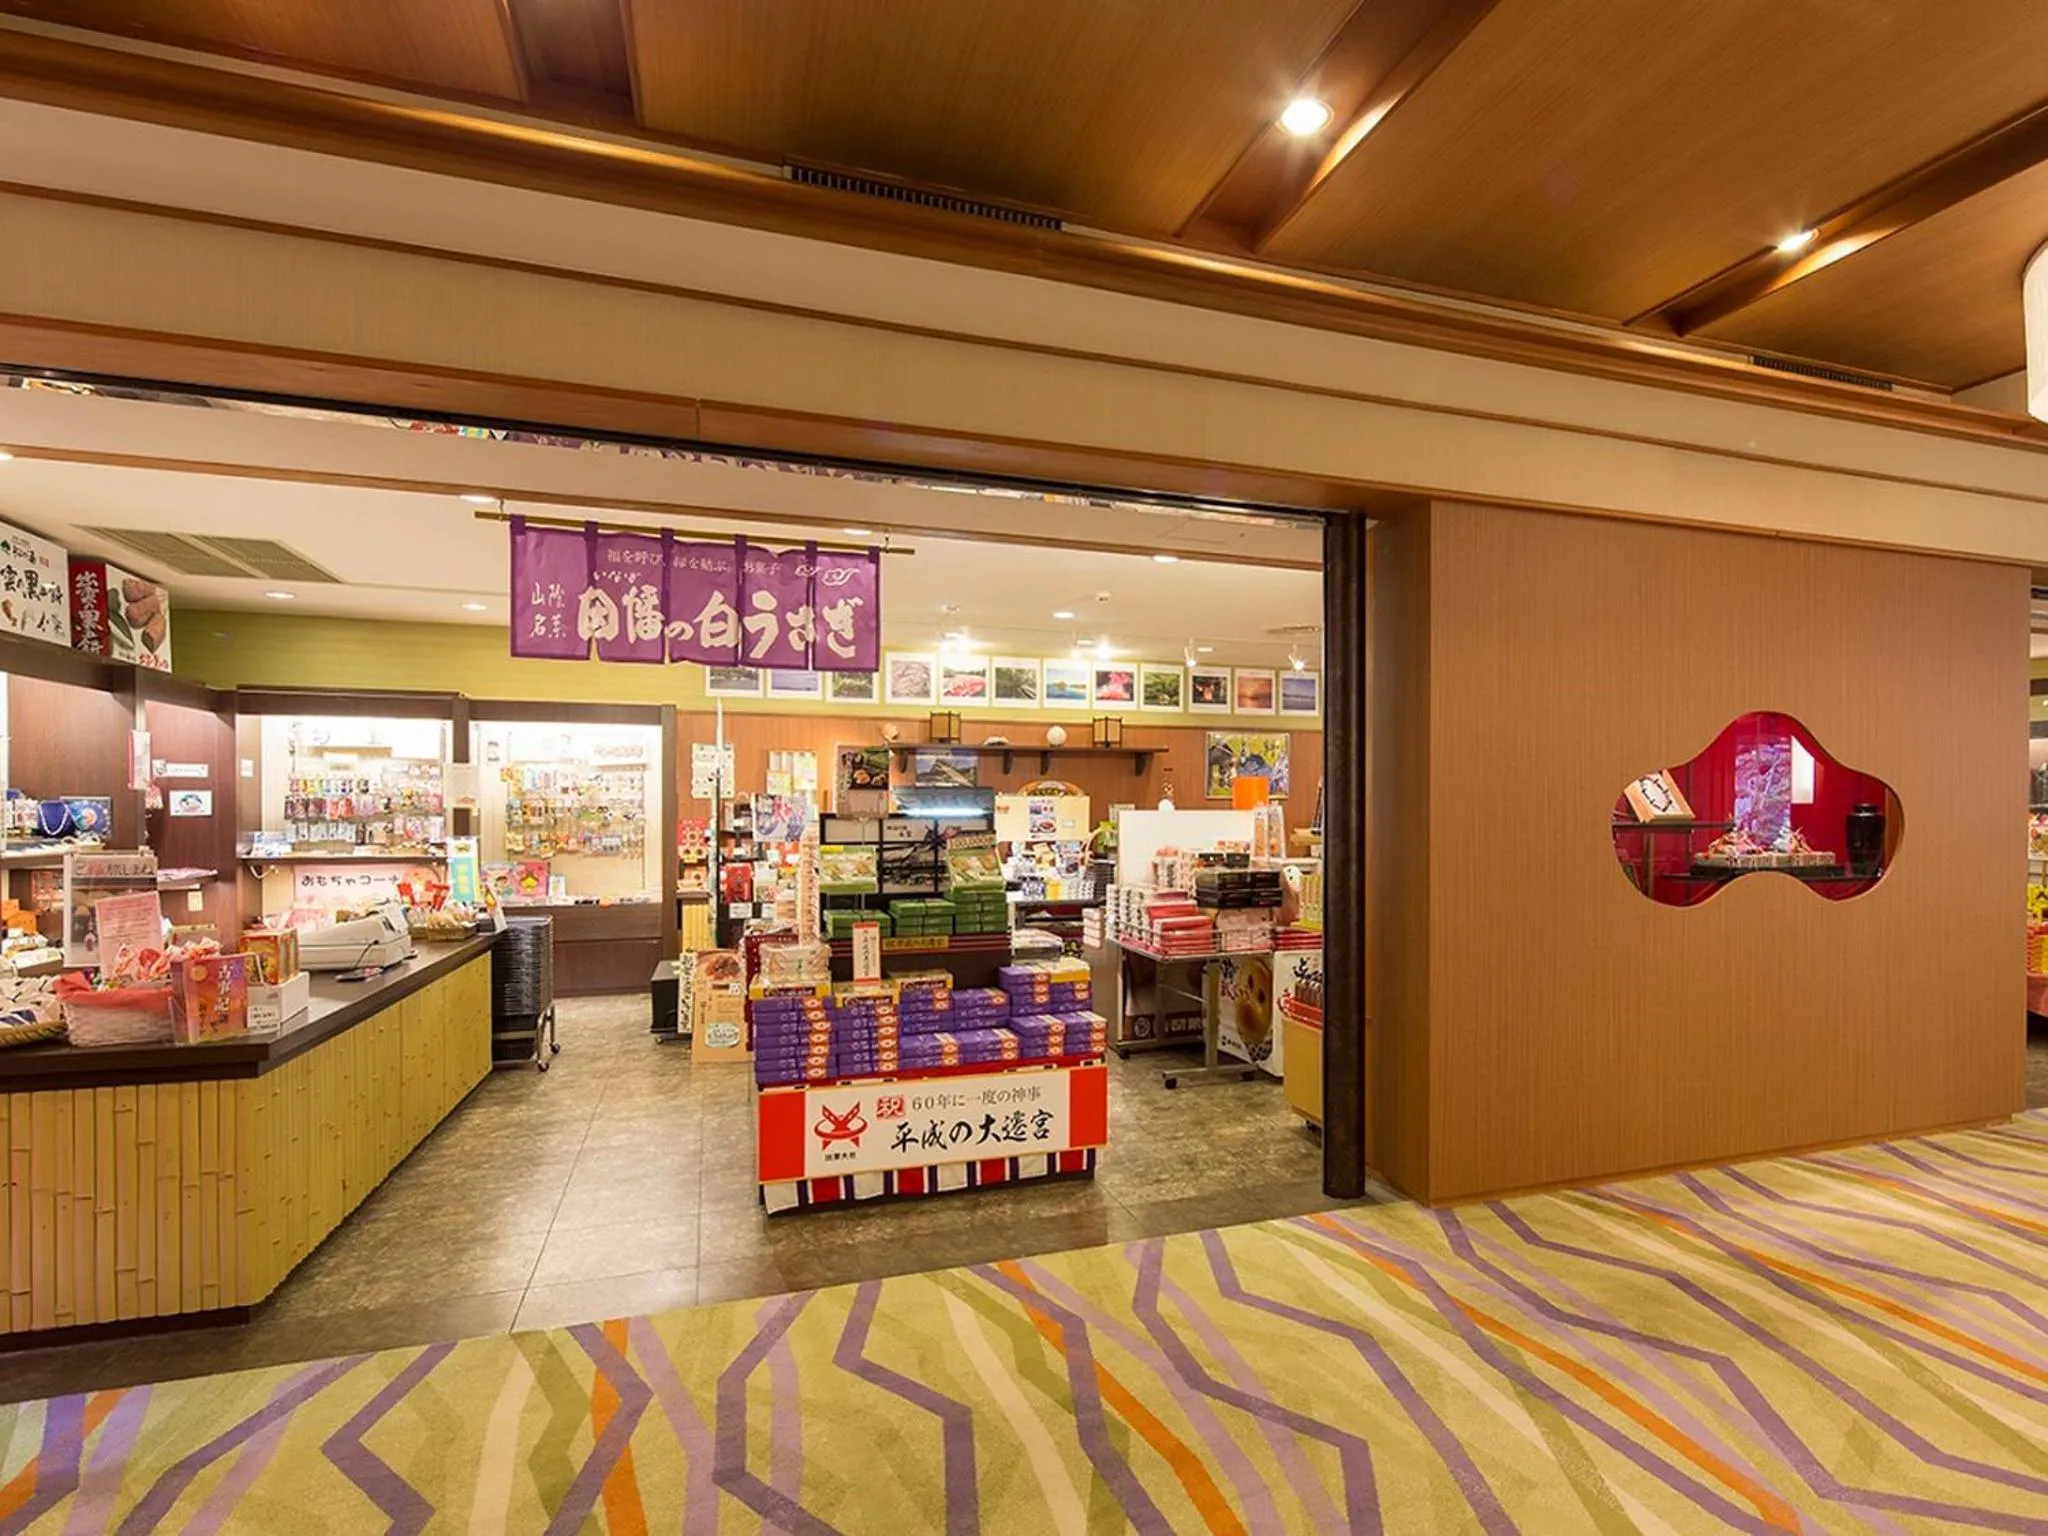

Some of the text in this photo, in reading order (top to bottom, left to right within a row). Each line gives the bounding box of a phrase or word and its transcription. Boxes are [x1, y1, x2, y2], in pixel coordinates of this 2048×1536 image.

[529, 613, 567, 640] 名菓
[577, 585, 864, 660] 因幡の白うさぎ
[301, 873, 400, 888] おもちゃコーナ
[911, 1086, 1042, 1112] 60年に一度の神事
[890, 1108, 1055, 1154] 平成の大遷宮
